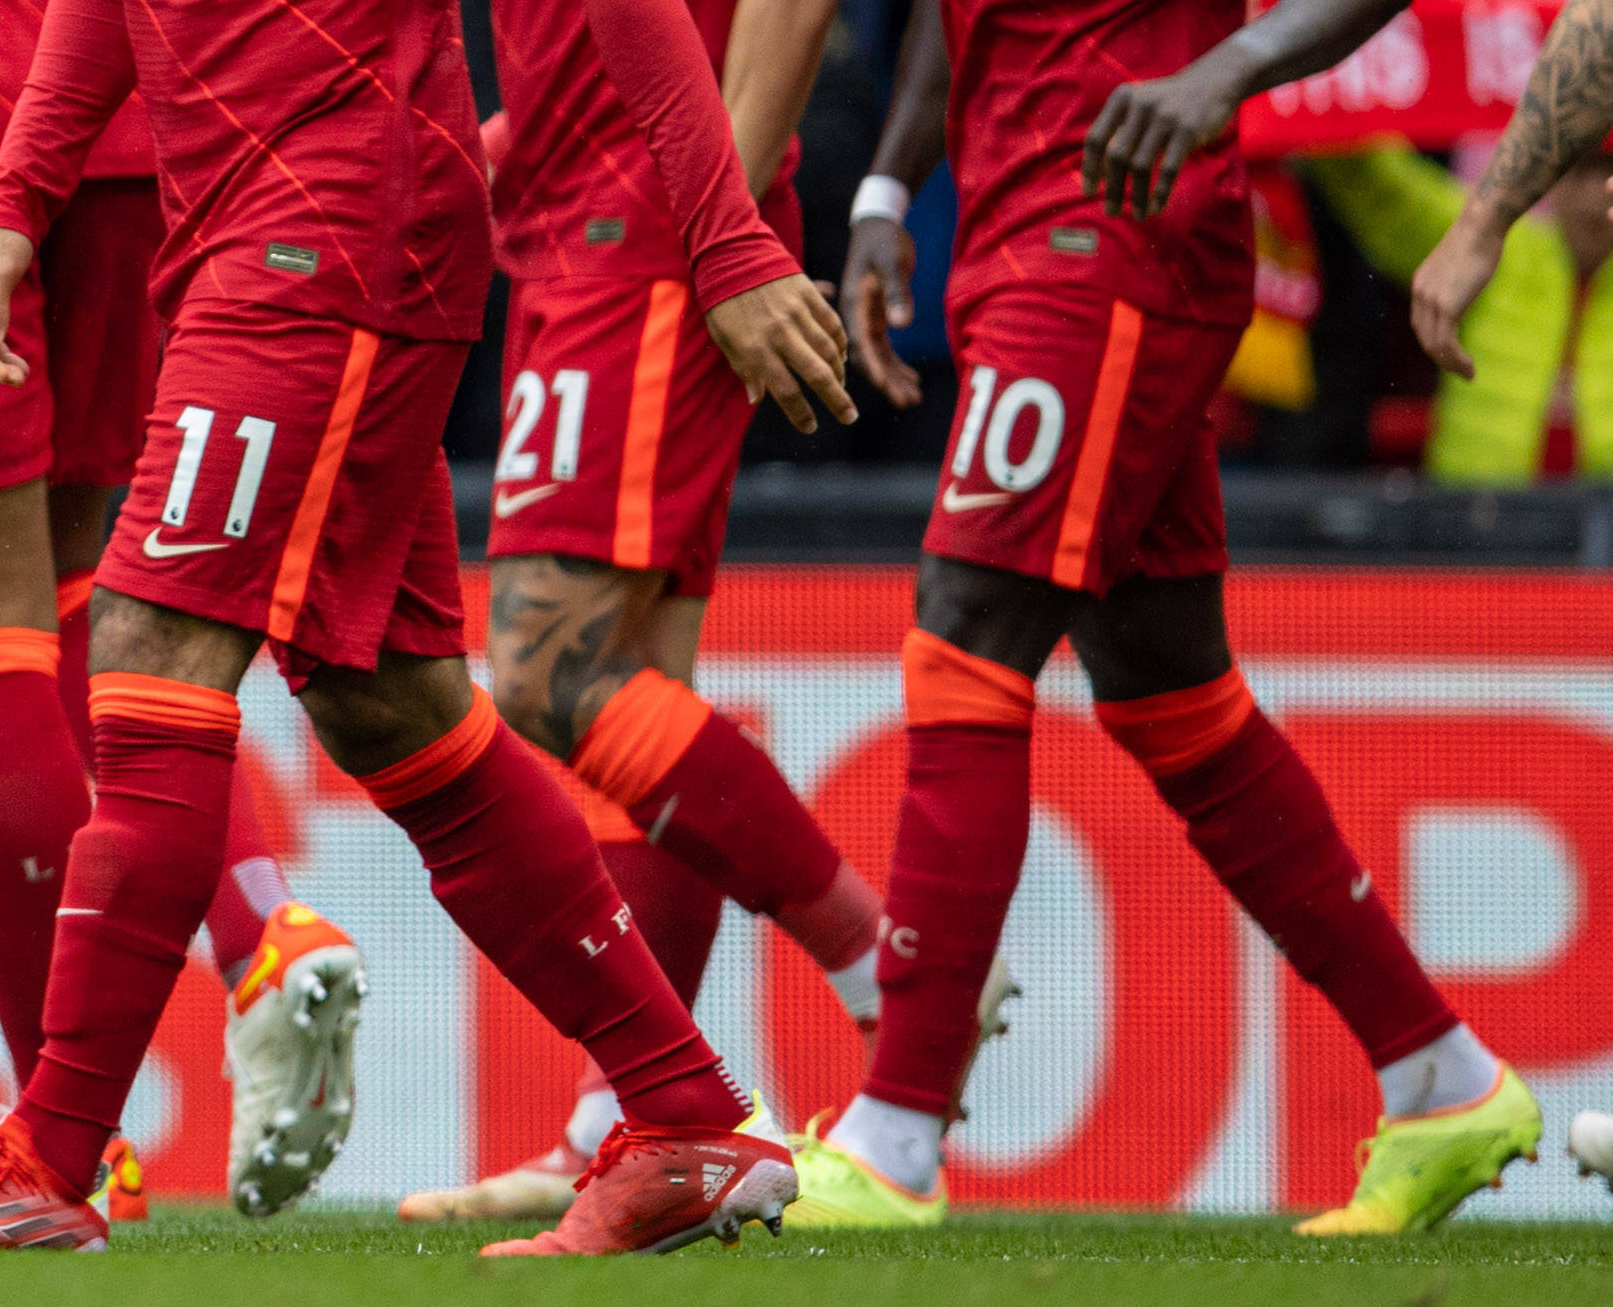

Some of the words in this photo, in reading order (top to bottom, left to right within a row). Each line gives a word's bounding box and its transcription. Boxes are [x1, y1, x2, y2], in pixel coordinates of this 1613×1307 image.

[160, 406, 277, 538] 11
[494, 368, 590, 481] 21
[951, 364, 1066, 492] 10
